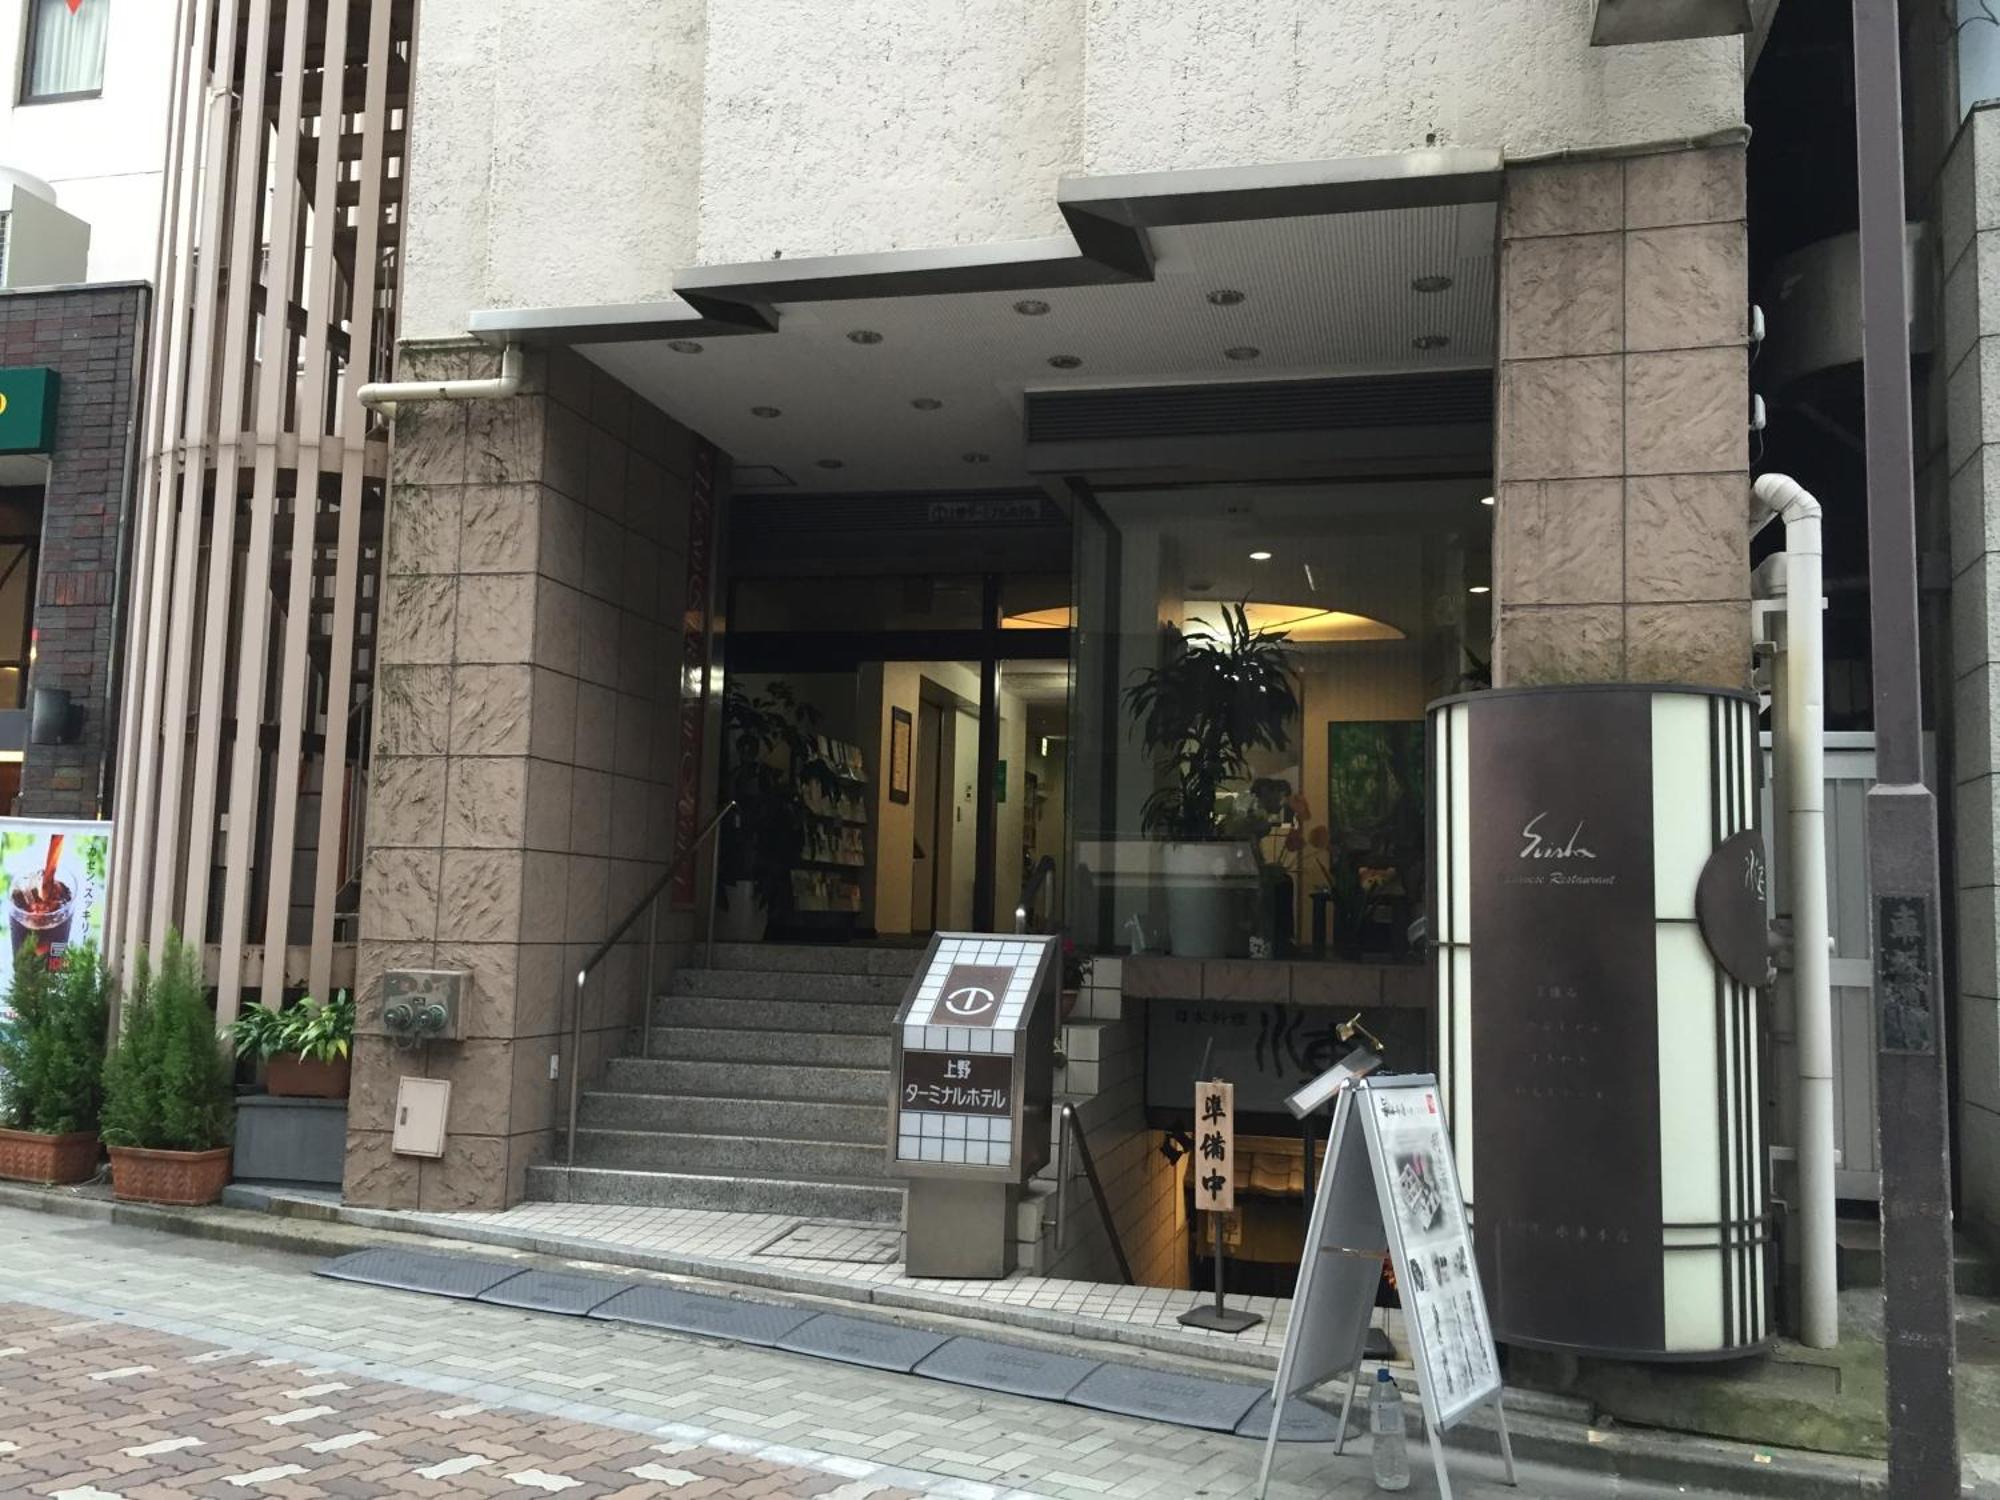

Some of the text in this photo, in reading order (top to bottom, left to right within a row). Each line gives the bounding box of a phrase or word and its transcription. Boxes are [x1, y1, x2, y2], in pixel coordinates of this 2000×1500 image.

[1550, 871, 1617, 885] Restaurant
[943, 1059, 971, 1079] 上野
[906, 1084, 1006, 1108] ターミナルホテル
[1200, 1094, 1227, 1201] 準備中
